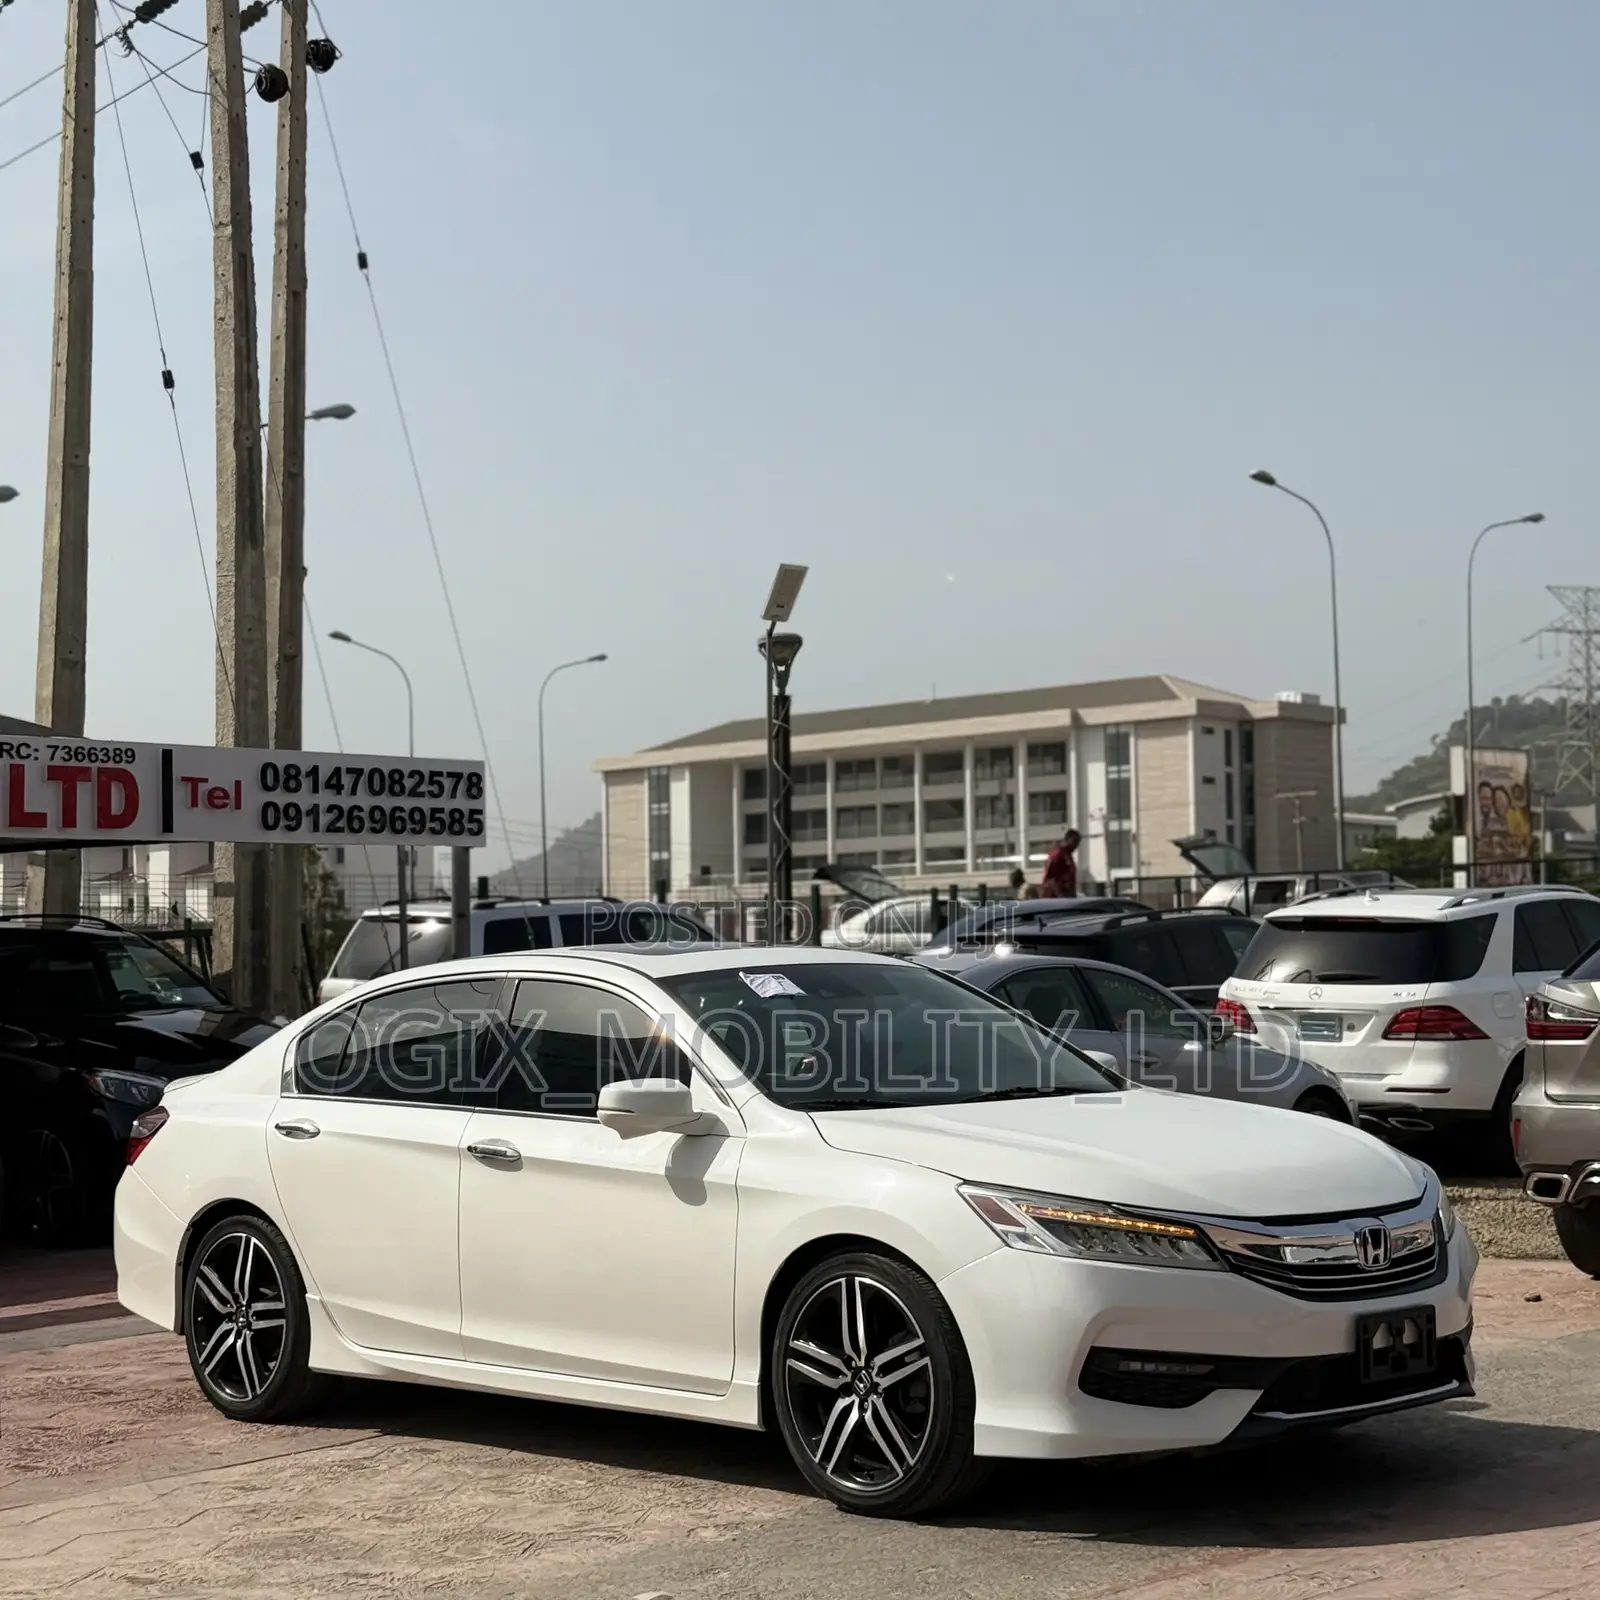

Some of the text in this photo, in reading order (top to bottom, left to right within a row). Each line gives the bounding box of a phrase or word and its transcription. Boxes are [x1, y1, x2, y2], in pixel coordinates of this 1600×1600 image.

[0, 742, 136, 764] RC: 7366389
[8, 763, 140, 829] LTD
[181, 776, 242, 810] Tel
[260, 762, 484, 799] 08147082578
[260, 801, 484, 836] 09126969585
